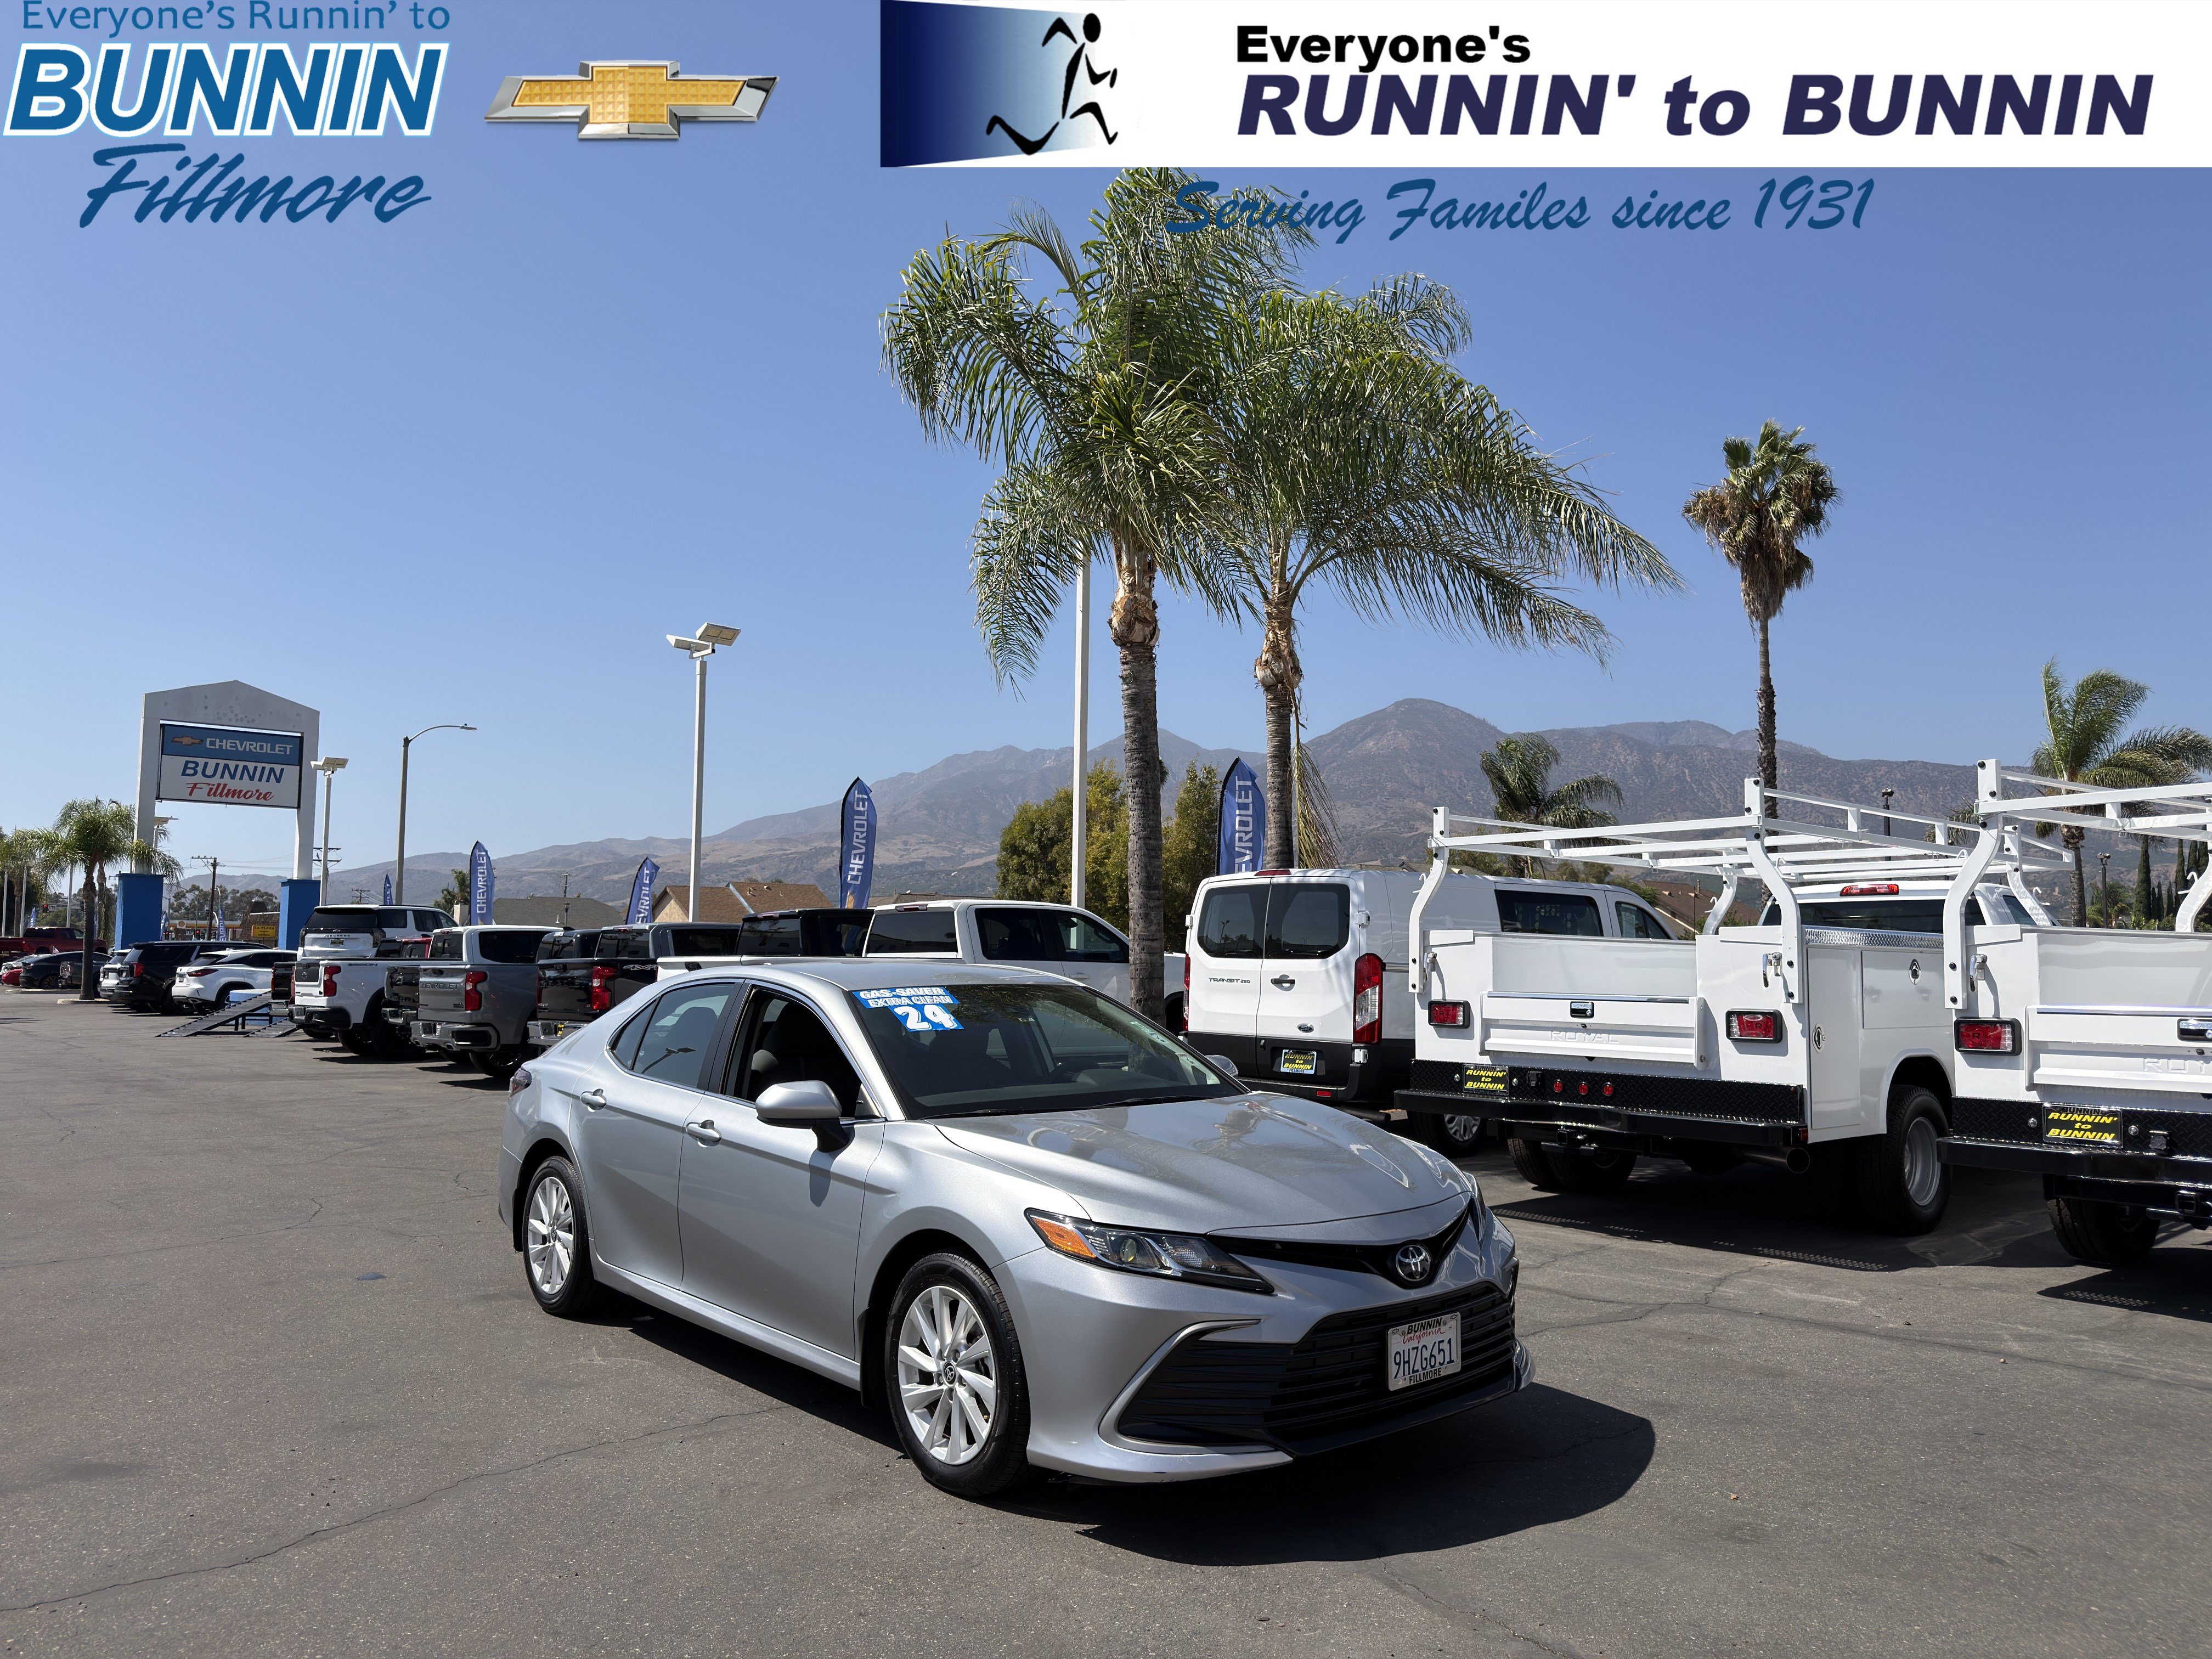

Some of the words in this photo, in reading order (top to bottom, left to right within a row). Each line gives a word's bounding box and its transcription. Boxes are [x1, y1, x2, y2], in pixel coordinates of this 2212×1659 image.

[206, 738, 293, 755] CHEVROLET
[181, 760, 285, 783] BUNNIN
[185, 782, 274, 801] Fillmore
[1234, 776, 1253, 873] EVROLET
[847, 790, 868, 885] CHEVROLET
[476, 849, 487, 913] CHEVROLET
[860, 987, 949, 999] GAS-SAVER
[868, 996, 913, 1007] EXTRA
[911, 995, 953, 1005] CLEAN
[894, 1005, 957, 1030] 24
[1551, 1031, 1618, 1043] ROYAL
[2143, 1058, 2212, 1075] ROY
[1466, 1081, 1505, 1090] BUNNIN
[2048, 1112, 2118, 1124] RUNNIN'
[2048, 1128, 2115, 1140] BUNNIN
[1407, 1317, 1442, 1334] BUNNIN
[1403, 1327, 1446, 1345] California
[1394, 1338, 1454, 1379] 9HZG651
[1409, 1368, 1442, 1384] FILLMORE
